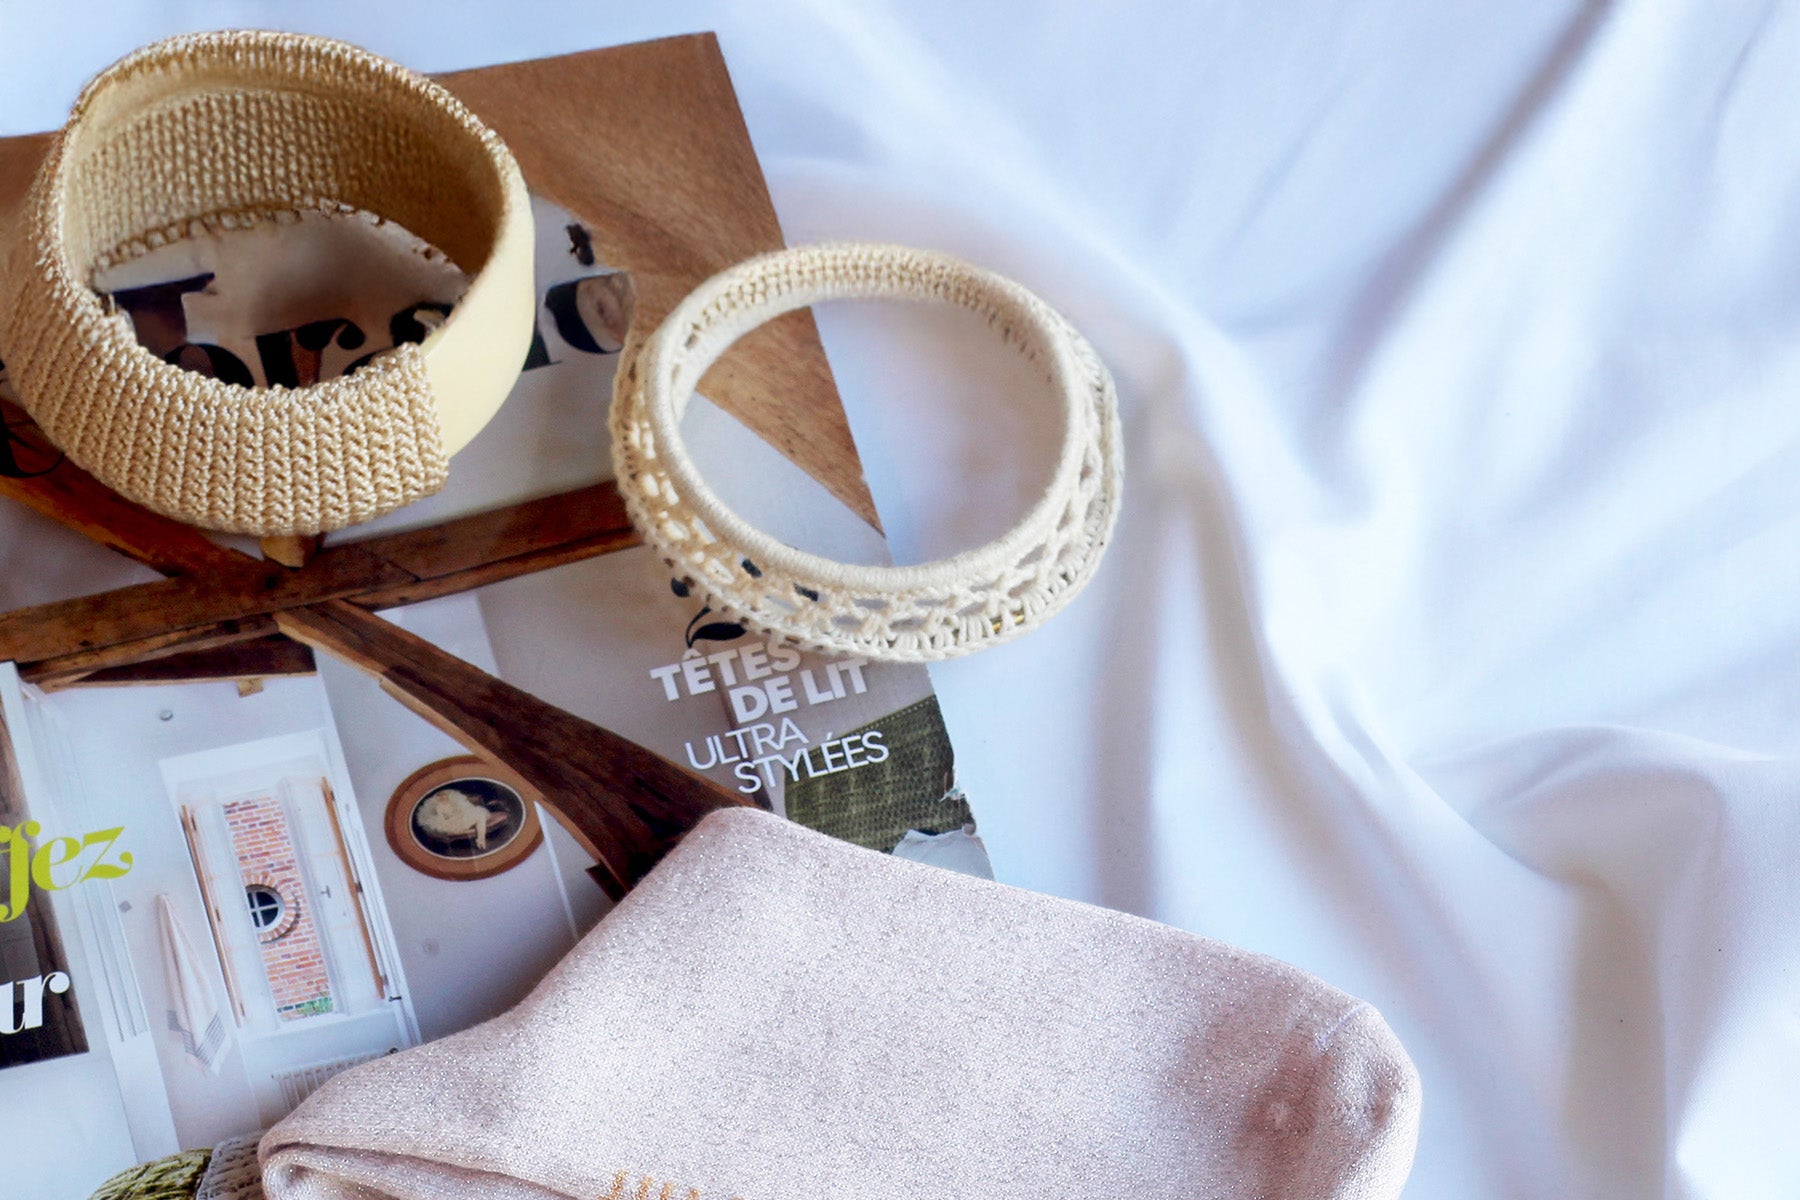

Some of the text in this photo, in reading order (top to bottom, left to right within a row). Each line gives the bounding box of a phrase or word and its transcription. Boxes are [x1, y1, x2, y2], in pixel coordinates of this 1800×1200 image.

[650, 641, 801, 701] TÊTES
[729, 660, 868, 724] DE LIT
[684, 716, 809, 771] ULTRA
[734, 730, 889, 794] STYLÉES
